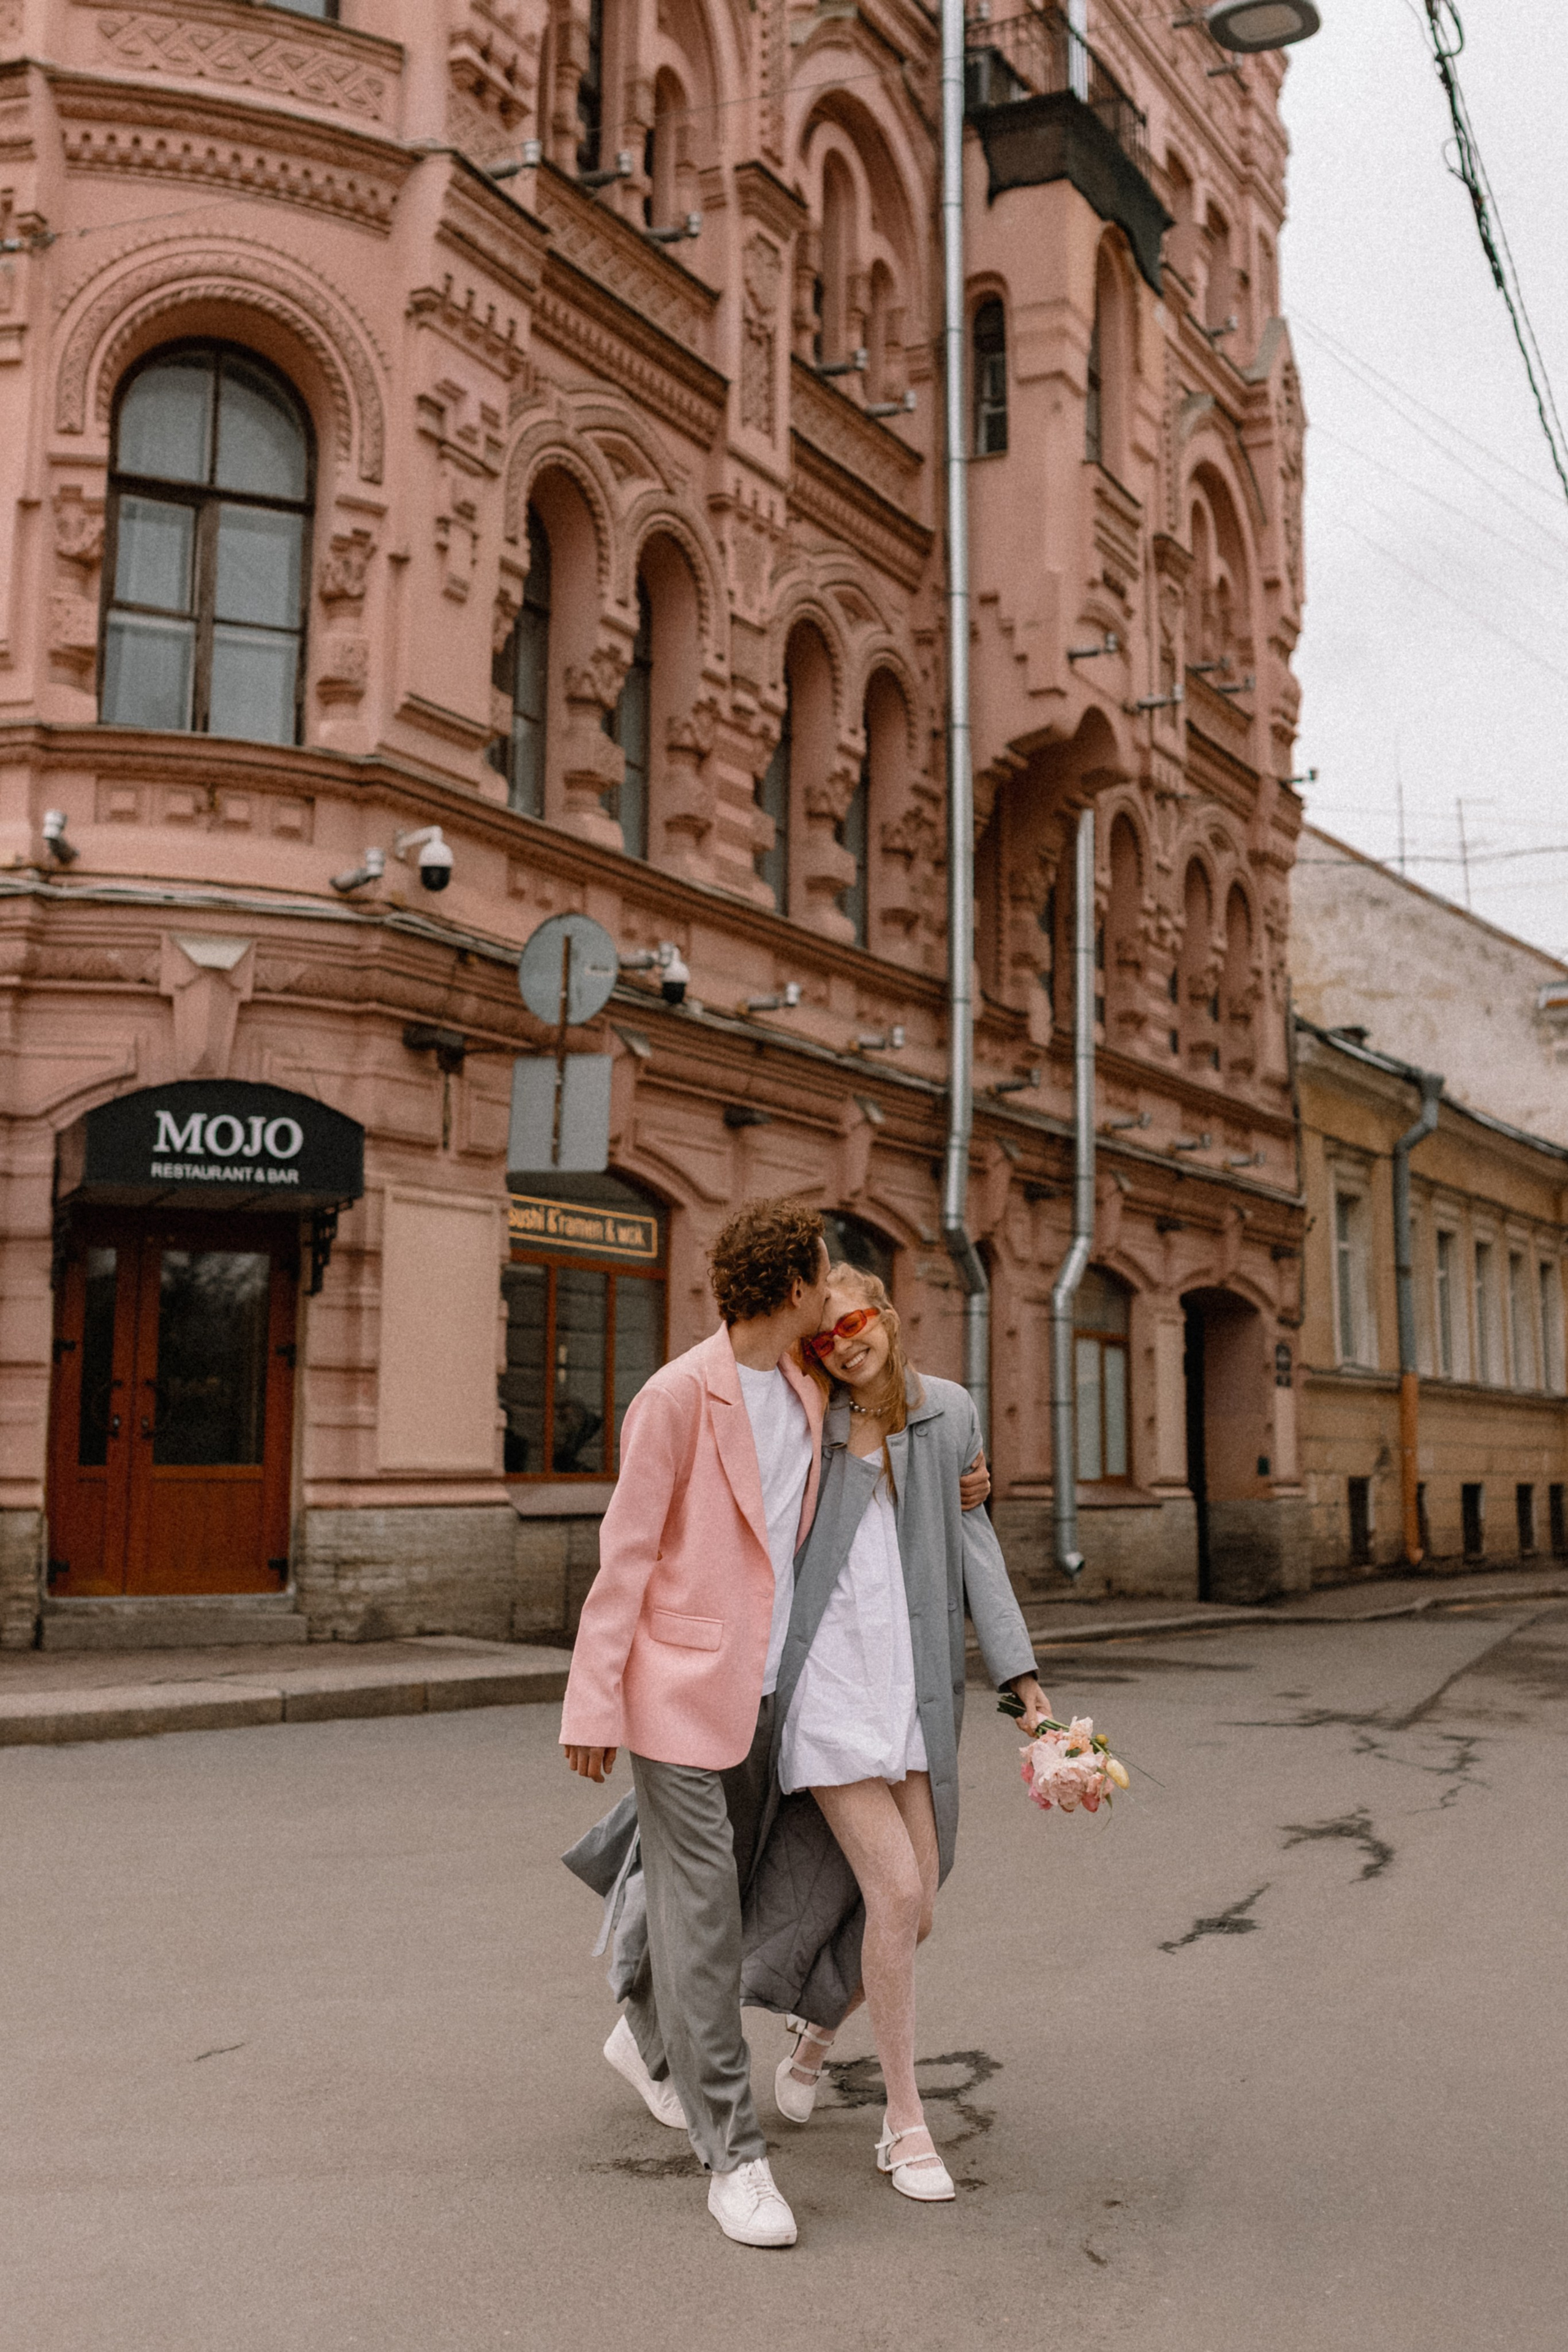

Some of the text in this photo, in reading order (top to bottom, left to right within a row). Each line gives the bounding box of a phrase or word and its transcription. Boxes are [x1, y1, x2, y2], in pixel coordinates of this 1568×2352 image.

[153, 1110, 303, 1159] MOJO
[151, 1163, 253, 1182] RESTAURANT
[267, 1168, 299, 1184] BAR
